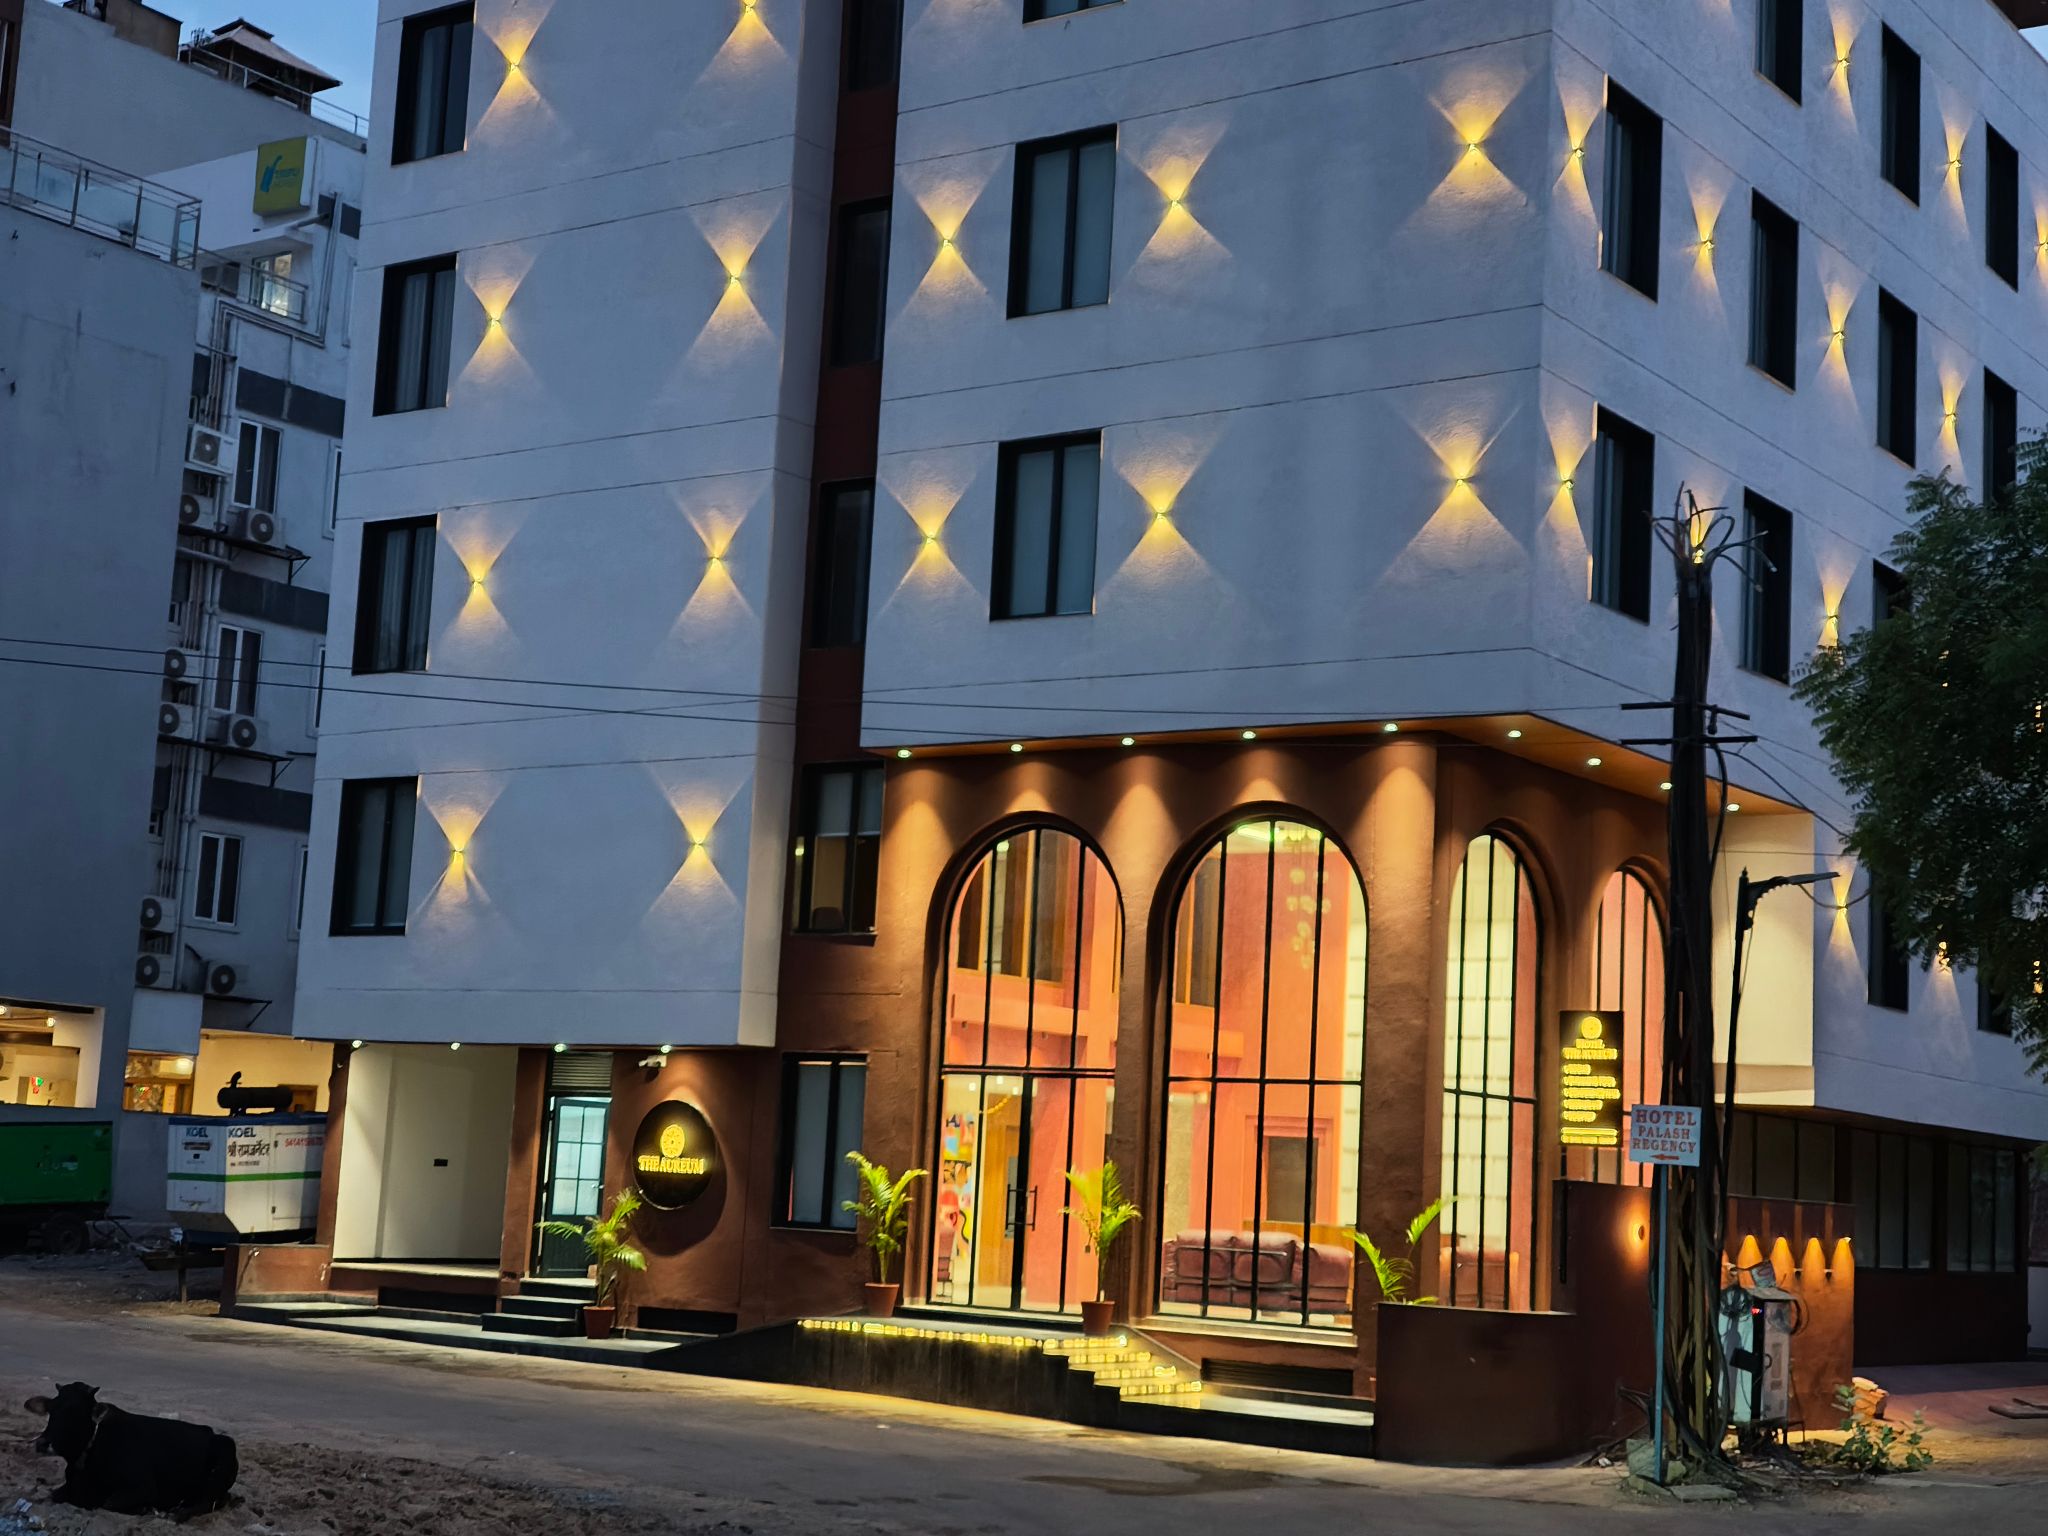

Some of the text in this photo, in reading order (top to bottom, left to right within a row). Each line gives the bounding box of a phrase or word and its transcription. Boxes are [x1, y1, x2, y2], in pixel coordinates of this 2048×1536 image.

[1635, 1109, 1697, 1126] HOTEL
[186, 1127, 208, 1138] KOEL
[227, 1127, 257, 1138] KOEL
[1638, 1125, 1690, 1140] PALASH
[1632, 1137, 1697, 1153] REGENCY
[638, 1155, 705, 1175] THE AUREUM
